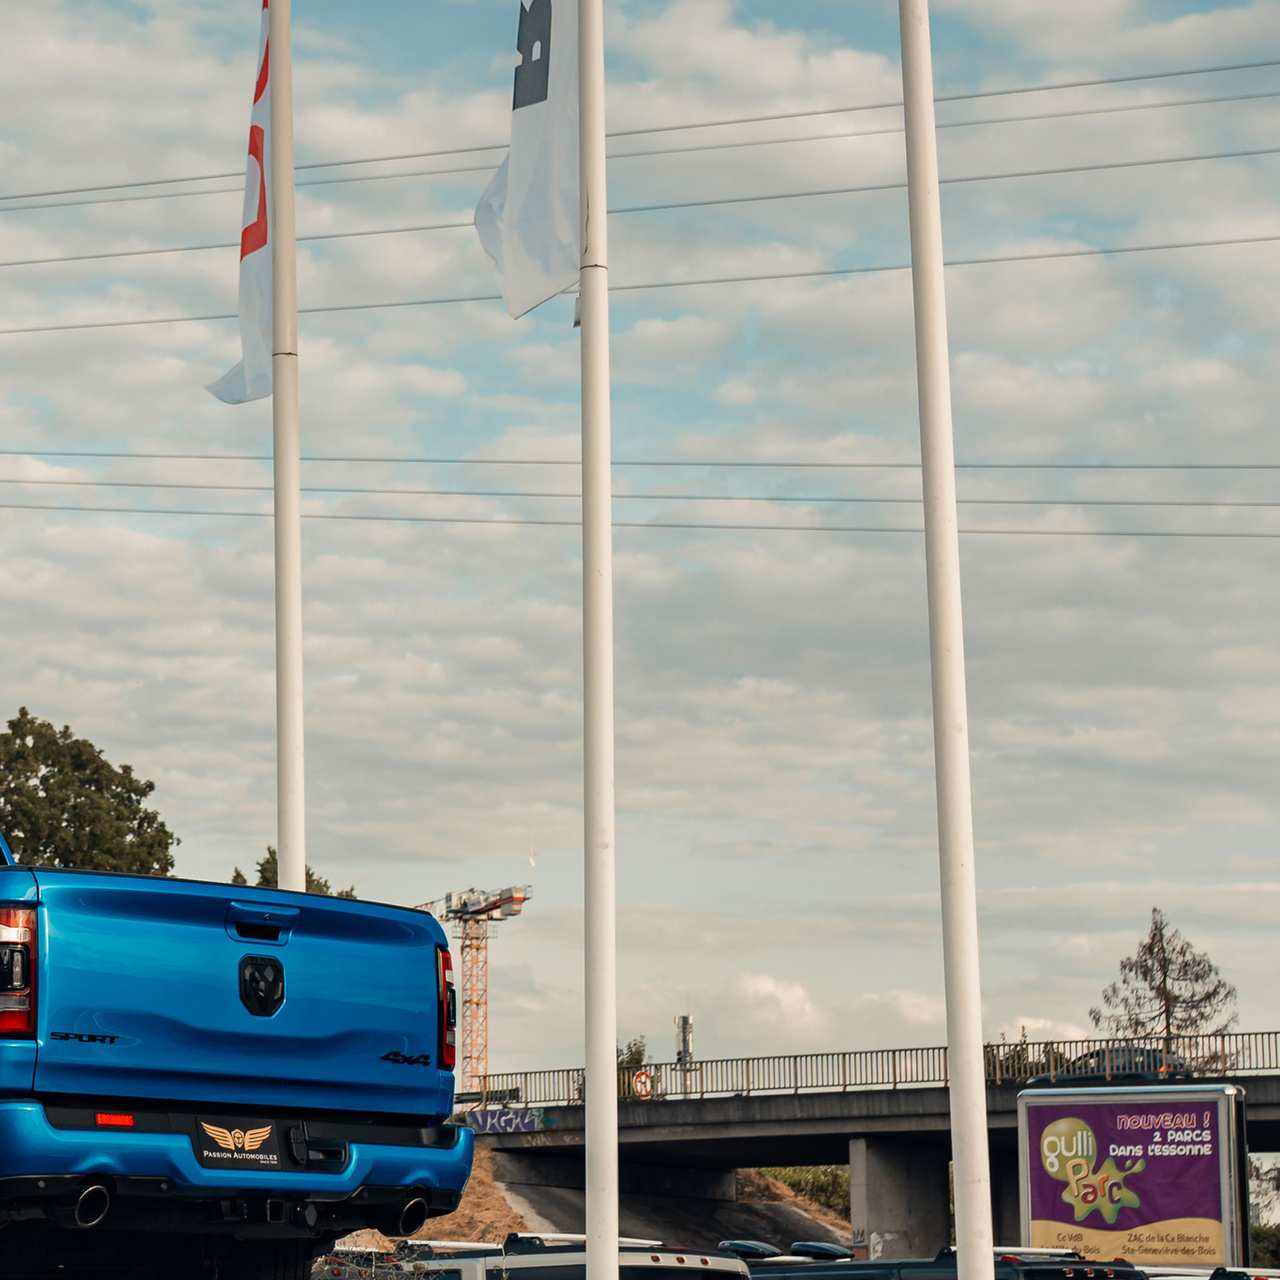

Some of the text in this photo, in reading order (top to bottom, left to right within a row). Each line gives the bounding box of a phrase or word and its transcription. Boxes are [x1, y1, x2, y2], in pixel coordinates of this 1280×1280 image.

[50, 1031, 120, 1044] SPORT
[1153, 1130, 1212, 1143] 2 PARCS
[1043, 1131, 1093, 1172] gulli
[1066, 1157, 1122, 1204] Parc
[1145, 1233, 1156, 1243] de
[1176, 1233, 1210, 1244] Blanche
